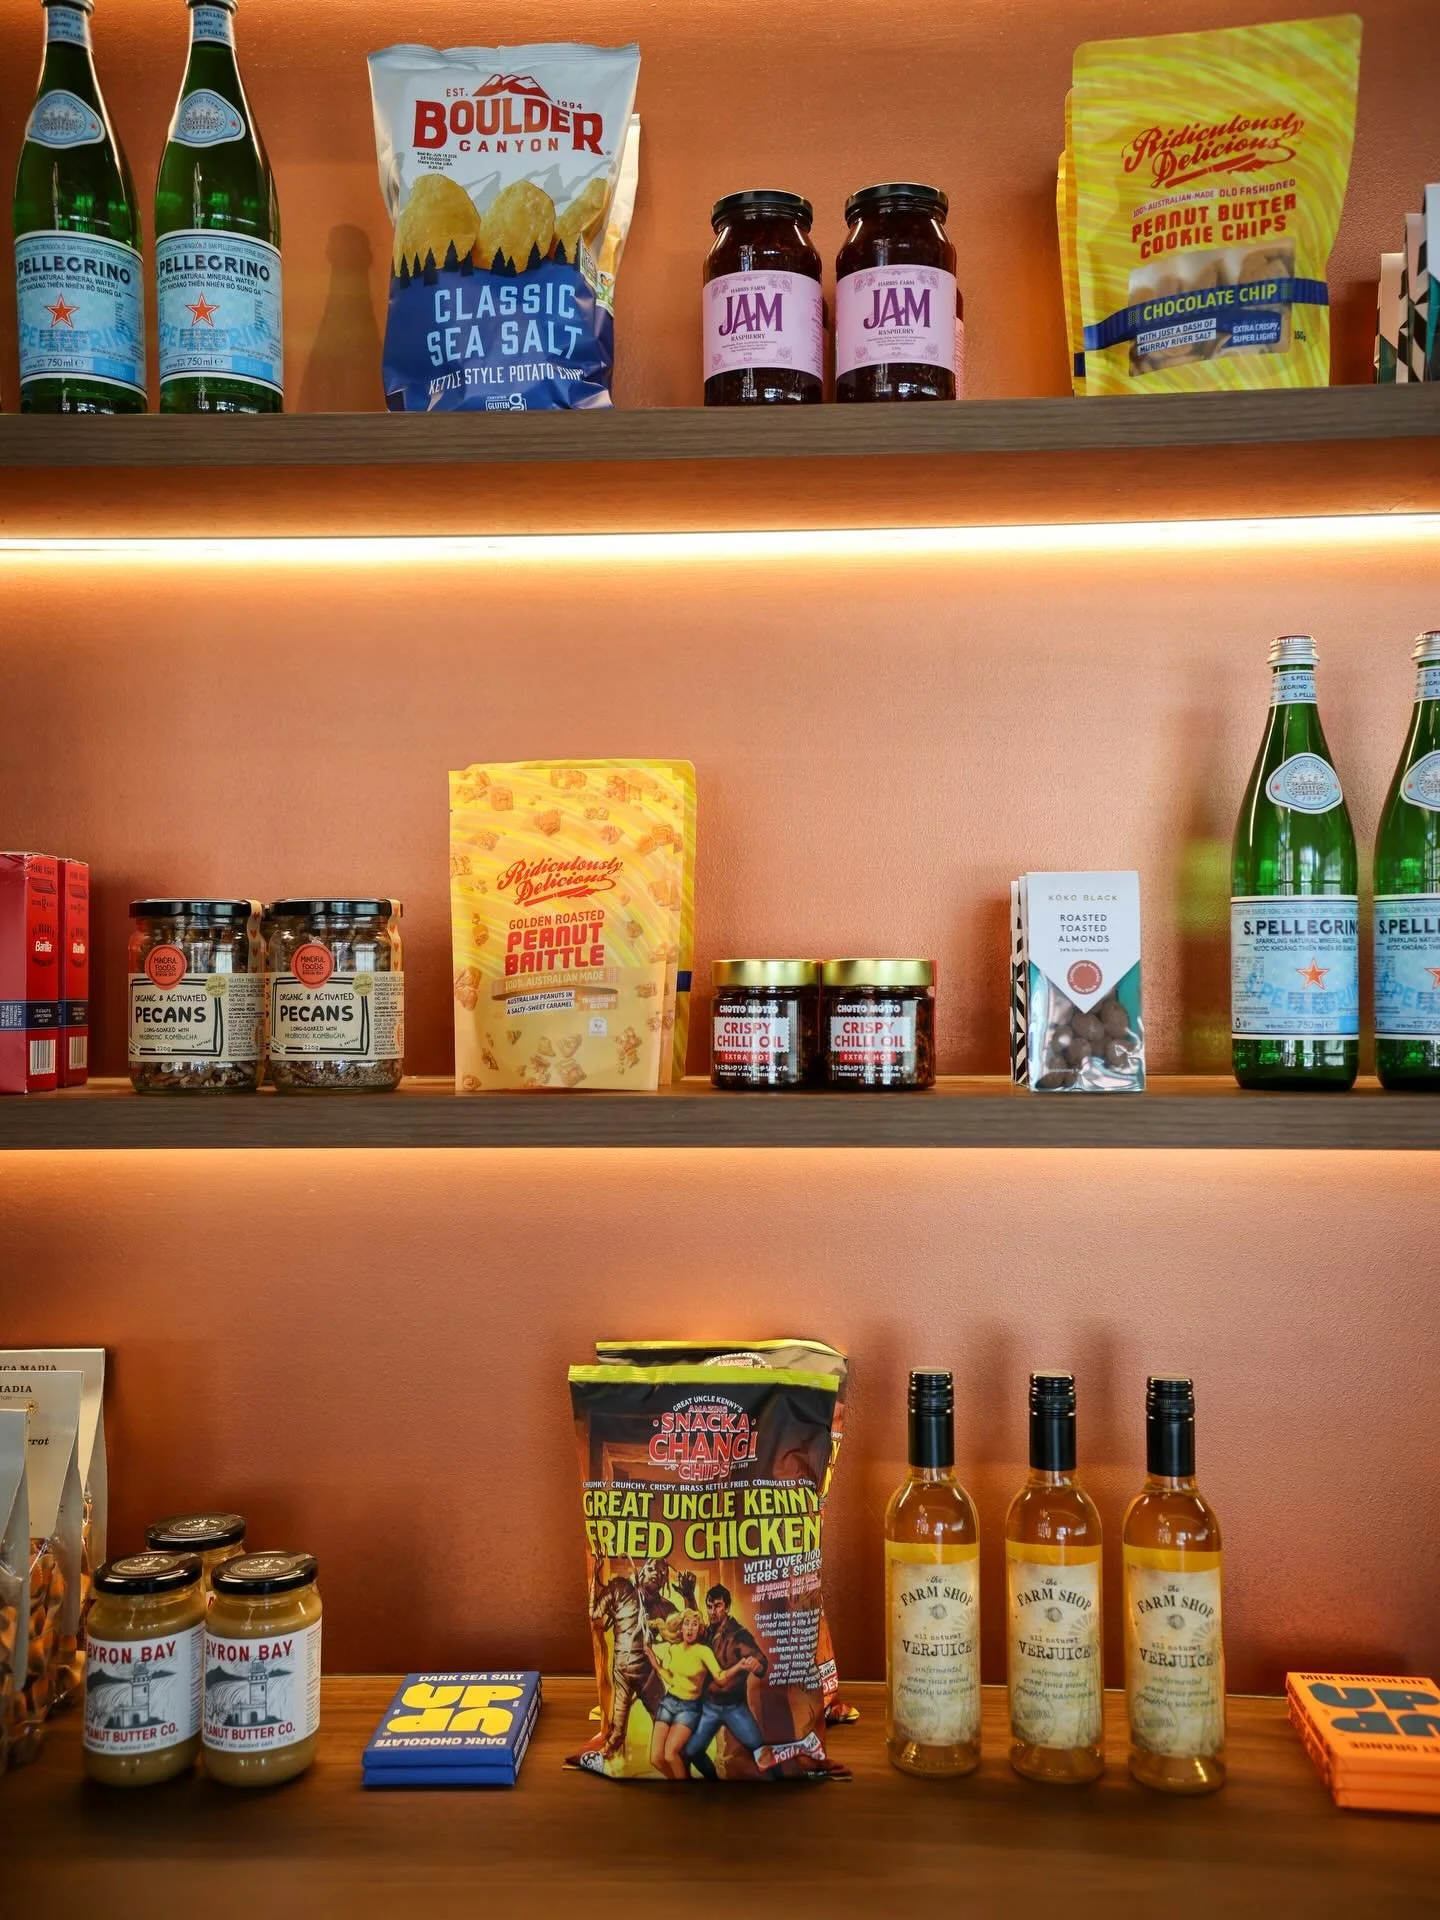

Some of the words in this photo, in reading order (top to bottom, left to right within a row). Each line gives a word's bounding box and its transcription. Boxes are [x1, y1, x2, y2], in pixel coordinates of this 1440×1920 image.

[446, 88, 469, 98] EST.
[557, 100, 582, 111] 1994
[412, 97, 605, 156] BOULDER
[459, 137, 560, 153] CANYON
[1121, 112, 1305, 173] Ridiculously
[1151, 135, 1292, 189] Delicious
[1219, 188, 1238, 198] OLD
[1239, 178, 1296, 196] FASHIONED
[1131, 205, 1210, 243] PEANUT
[1218, 193, 1297, 222] BUTTER
[1140, 225, 1213, 260] COOKIE
[1222, 214, 1287, 242] CHIPS
[434, 282, 576, 324] CLASSIC
[863, 287, 931, 329] JAM
[1143, 290, 1235, 321] CHOCOLATE
[1239, 284, 1278, 302] CHIP
[718, 292, 784, 336] JAM
[1139, 332, 1157, 342] WITH
[1158, 329, 1175, 338] JUST
[1182, 323, 1199, 333] DASH
[1199, 321, 1213, 329] OF
[1232, 324, 1254, 334] EXTRA
[426, 325, 486, 367] SEA
[501, 319, 583, 360] SALT
[1139, 341, 1169, 354] MURRAY
[1170, 336, 1194, 347] RIVER
[1194, 331, 1212, 342] SALT
[1232, 333, 1255, 344] SUPER
[47, 358, 62, 367] 750
[187, 357, 202, 366] 750
[428, 370, 462, 395] KETTLE
[464, 366, 505, 385] STYLE
[509, 363, 555, 383] POTATO
[487, 401, 510, 410] GLUTEN
[496, 855, 624, 890] Ridiculously
[513, 872, 610, 906] Delicious
[509, 915, 552, 930] GOLDEN
[555, 910, 606, 925] ROASTED
[1060, 914, 1107, 922] ROASTED
[1060, 924, 1107, 932] TOASTED
[35, 940, 53, 953] Barilla
[507, 922, 604, 953] PEANUT
[1058, 935, 1110, 943] ALMONDS
[527, 972, 578, 987] AUSTRALIAN
[580, 970, 605, 982] MADE
[166, 993, 208, 1002] ACTIVATED
[313, 992, 355, 1001] ACTIVATED
[507, 995, 539, 1005] AUSTRALIAN
[539, 992, 565, 1001] PEANUTS
[135, 1005, 207, 1024] PECANS
[280, 1004, 354, 1022] PECANS
[511, 1004, 546, 1014] SALTY-SWEET
[546, 1001, 573, 1010] CARAMEL
[719, 1004, 747, 1014] CHOTTO
[837, 1004, 867, 1013] CHOTTO
[723, 1022, 771, 1034] CRISPY
[842, 1021, 895, 1034] CRISPY
[717, 1035, 753, 1048] CHILLI
[834, 1035, 875, 1047] CHILLI
[880, 1035, 905, 1047] OIL
[673, 1397, 693, 1412] GREAT
[693, 1395, 716, 1403] UNCLE
[715, 1396, 744, 1413] KENNY'S
[661, 1412, 750, 1433] SNACKA
[679, 1462, 730, 1481] CHIPS
[680, 1484, 704, 1492] BRASS
[705, 1481, 729, 1491] KETTLE
[752, 1478, 796, 1487] CORRUGATED
[582, 1490, 655, 1518] GREAT
[662, 1490, 736, 1520] UNCLE
[743, 1486, 820, 1516] KENNY
[585, 1519, 674, 1559] FRIED
[684, 1514, 821, 1561] CHICKEN
[743, 1559, 773, 1574] WITH
[775, 1554, 803, 1569] OVER
[743, 1569, 779, 1585] HERBS
[782, 1567, 790, 1579] &
[930, 1575, 943, 1584] the
[900, 1585, 938, 1608] FARM
[943, 1586, 974, 1608] SHOP
[1016, 1588, 1054, 1608] FARM
[1059, 1588, 1093, 1613] SHOP
[1137, 1594, 1176, 1615] FARM
[1181, 1595, 1215, 1619] SHOP
[754, 1612, 772, 1621] Great
[773, 1612, 791, 1620] Uncle
[756, 1621, 778, 1629] turned
[930, 1632, 963, 1641] natural
[1046, 1636, 1080, 1645] natural
[86, 1641, 132, 1665] BYRON
[140, 1640, 177, 1662] BAY
[205, 1639, 250, 1662] BYRON
[258, 1639, 293, 1661] BAY
[768, 1644, 798, 1654] salesman
[779, 1653, 792, 1661] him
[792, 1652, 805, 1660] into
[902, 1639, 973, 1657] VERJUICE
[1018, 1640, 1092, 1661] VERJUICE
[1168, 1643, 1202, 1652] natural
[1139, 1647, 1215, 1669] VERJUICE
[418, 1673, 459, 1682] DARK
[460, 1673, 488, 1681] SEA
[490, 1673, 524, 1681] SALT
[768, 1672, 782, 1680] pair
[768, 1679, 776, 1687] of
[776, 1678, 787, 1686] the
[787, 1676, 804, 1684] more
[1300, 1674, 1336, 1682] MILK
[1339, 1675, 1429, 1686] CHOCOLATE
[401, 1682, 524, 1709] UP
[231, 1726, 275, 1741] BUTTER
[278, 1721, 296, 1735] CO.
[386, 1707, 514, 1737] UP
[112, 1727, 157, 1743] BUTTER
[160, 1721, 179, 1737] CO.
[374, 1737, 464, 1748] CHOCOLATE
[465, 1737, 507, 1746] DARK
